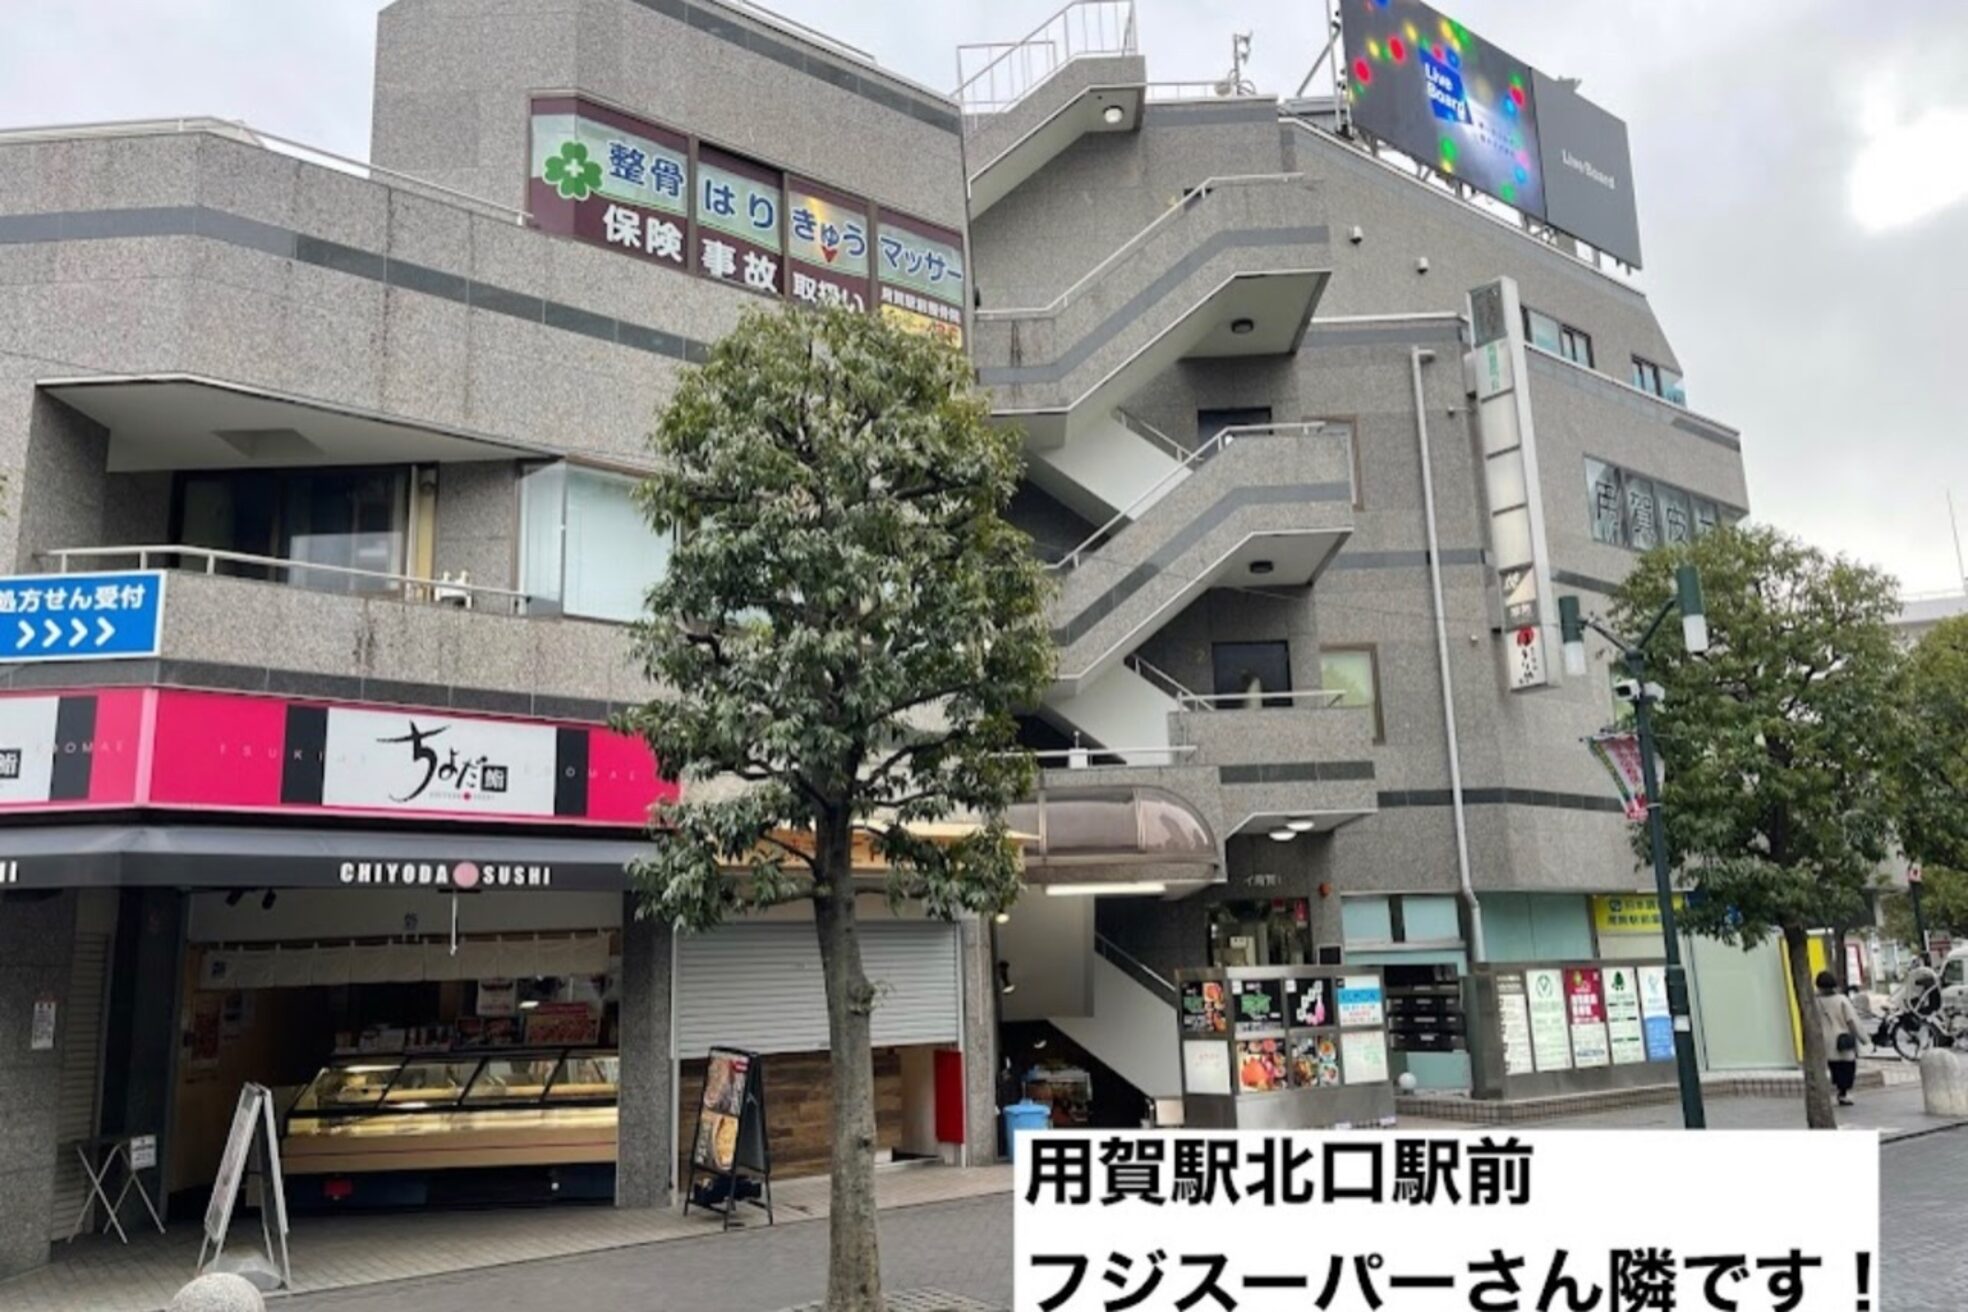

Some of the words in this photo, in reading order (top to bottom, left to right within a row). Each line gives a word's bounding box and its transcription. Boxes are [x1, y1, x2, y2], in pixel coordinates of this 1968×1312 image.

[1424, 62, 1453, 91] Live
[1426, 81, 1466, 121] Board
[607, 140, 685, 197] 整骨
[704, 179, 775, 229] はり
[791, 208, 867, 257] きゅう
[879, 236, 963, 283] マッサー
[602, 202, 685, 264] 保険
[700, 236, 779, 295] 事故
[792, 271, 865, 314] 取扱い
[0, 583, 146, 613] 処方せん受付
[340, 861, 449, 884] CHIYODA
[482, 864, 552, 886] SUSHI
